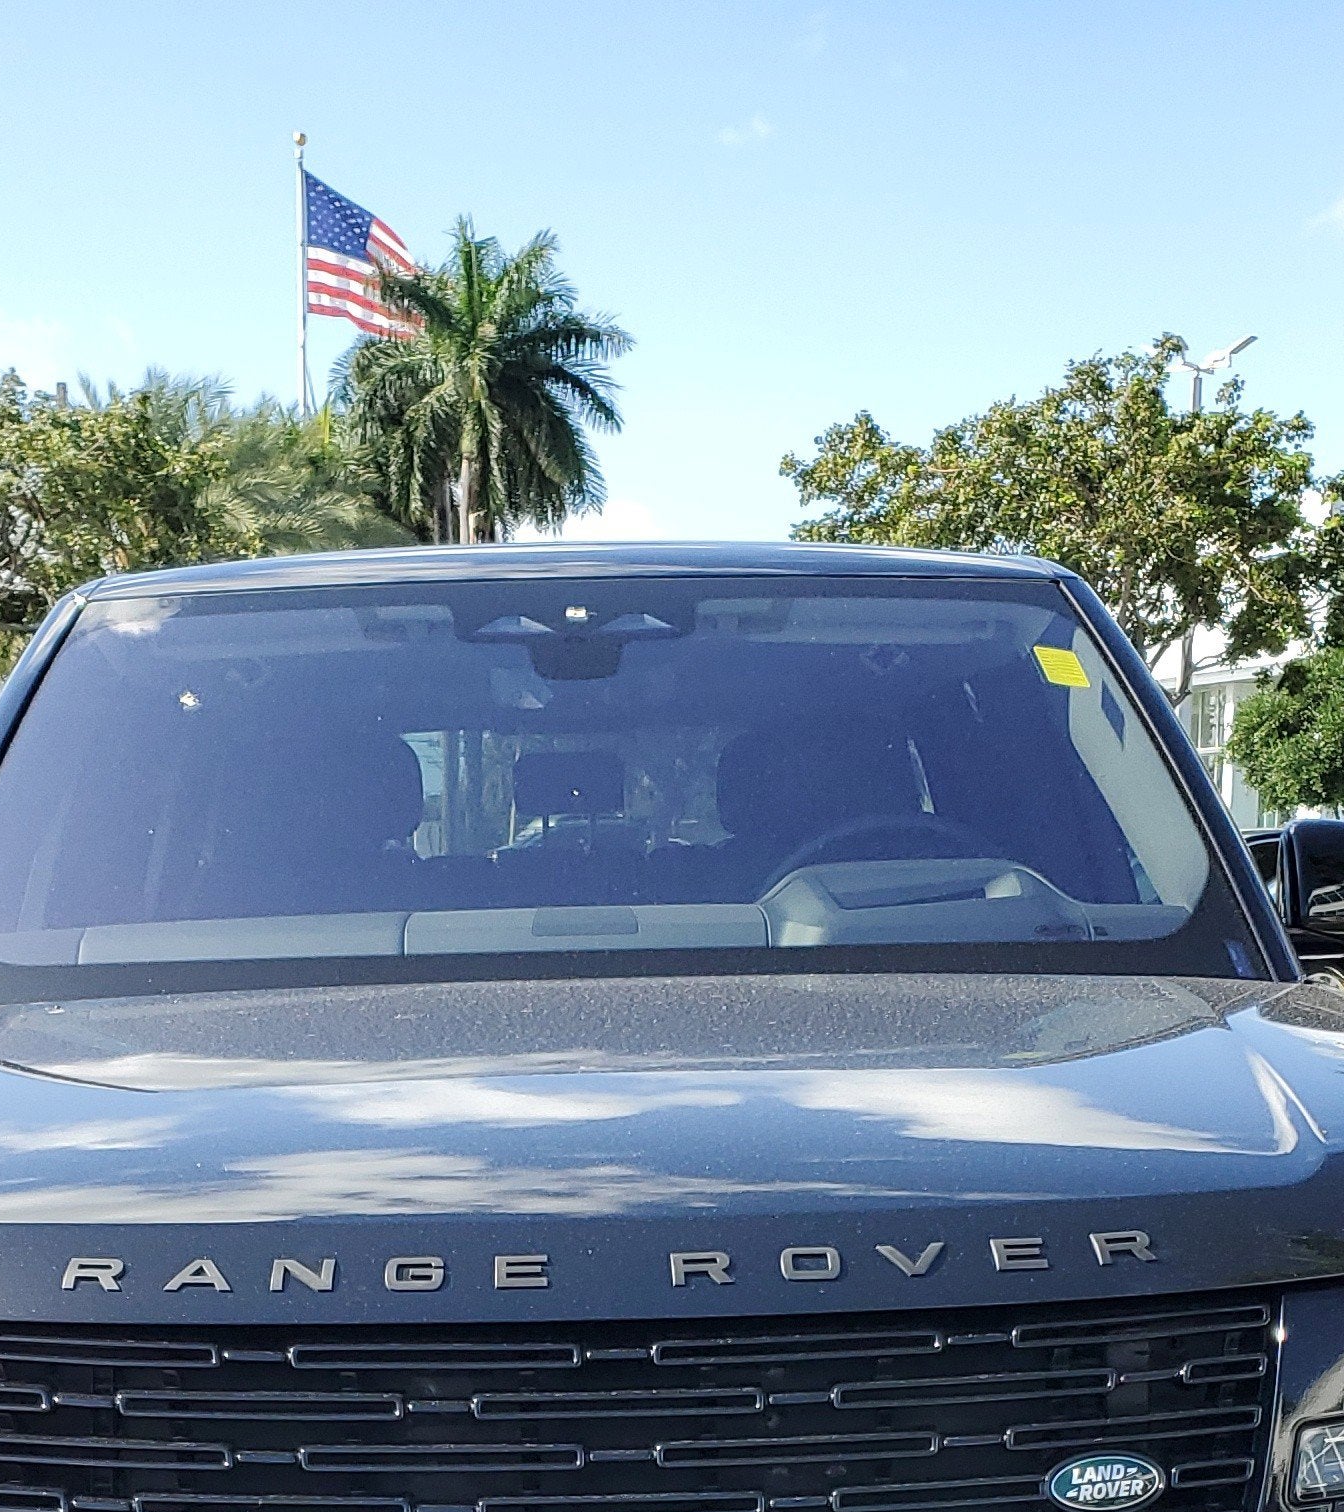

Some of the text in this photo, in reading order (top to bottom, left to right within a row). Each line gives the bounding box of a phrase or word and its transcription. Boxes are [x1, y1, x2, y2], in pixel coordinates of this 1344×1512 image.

[61, 1229, 1156, 1293] RANGE ROVER
[1071, 1464, 1125, 1485] LAND
[1077, 1479, 1144, 1502] ROVER
